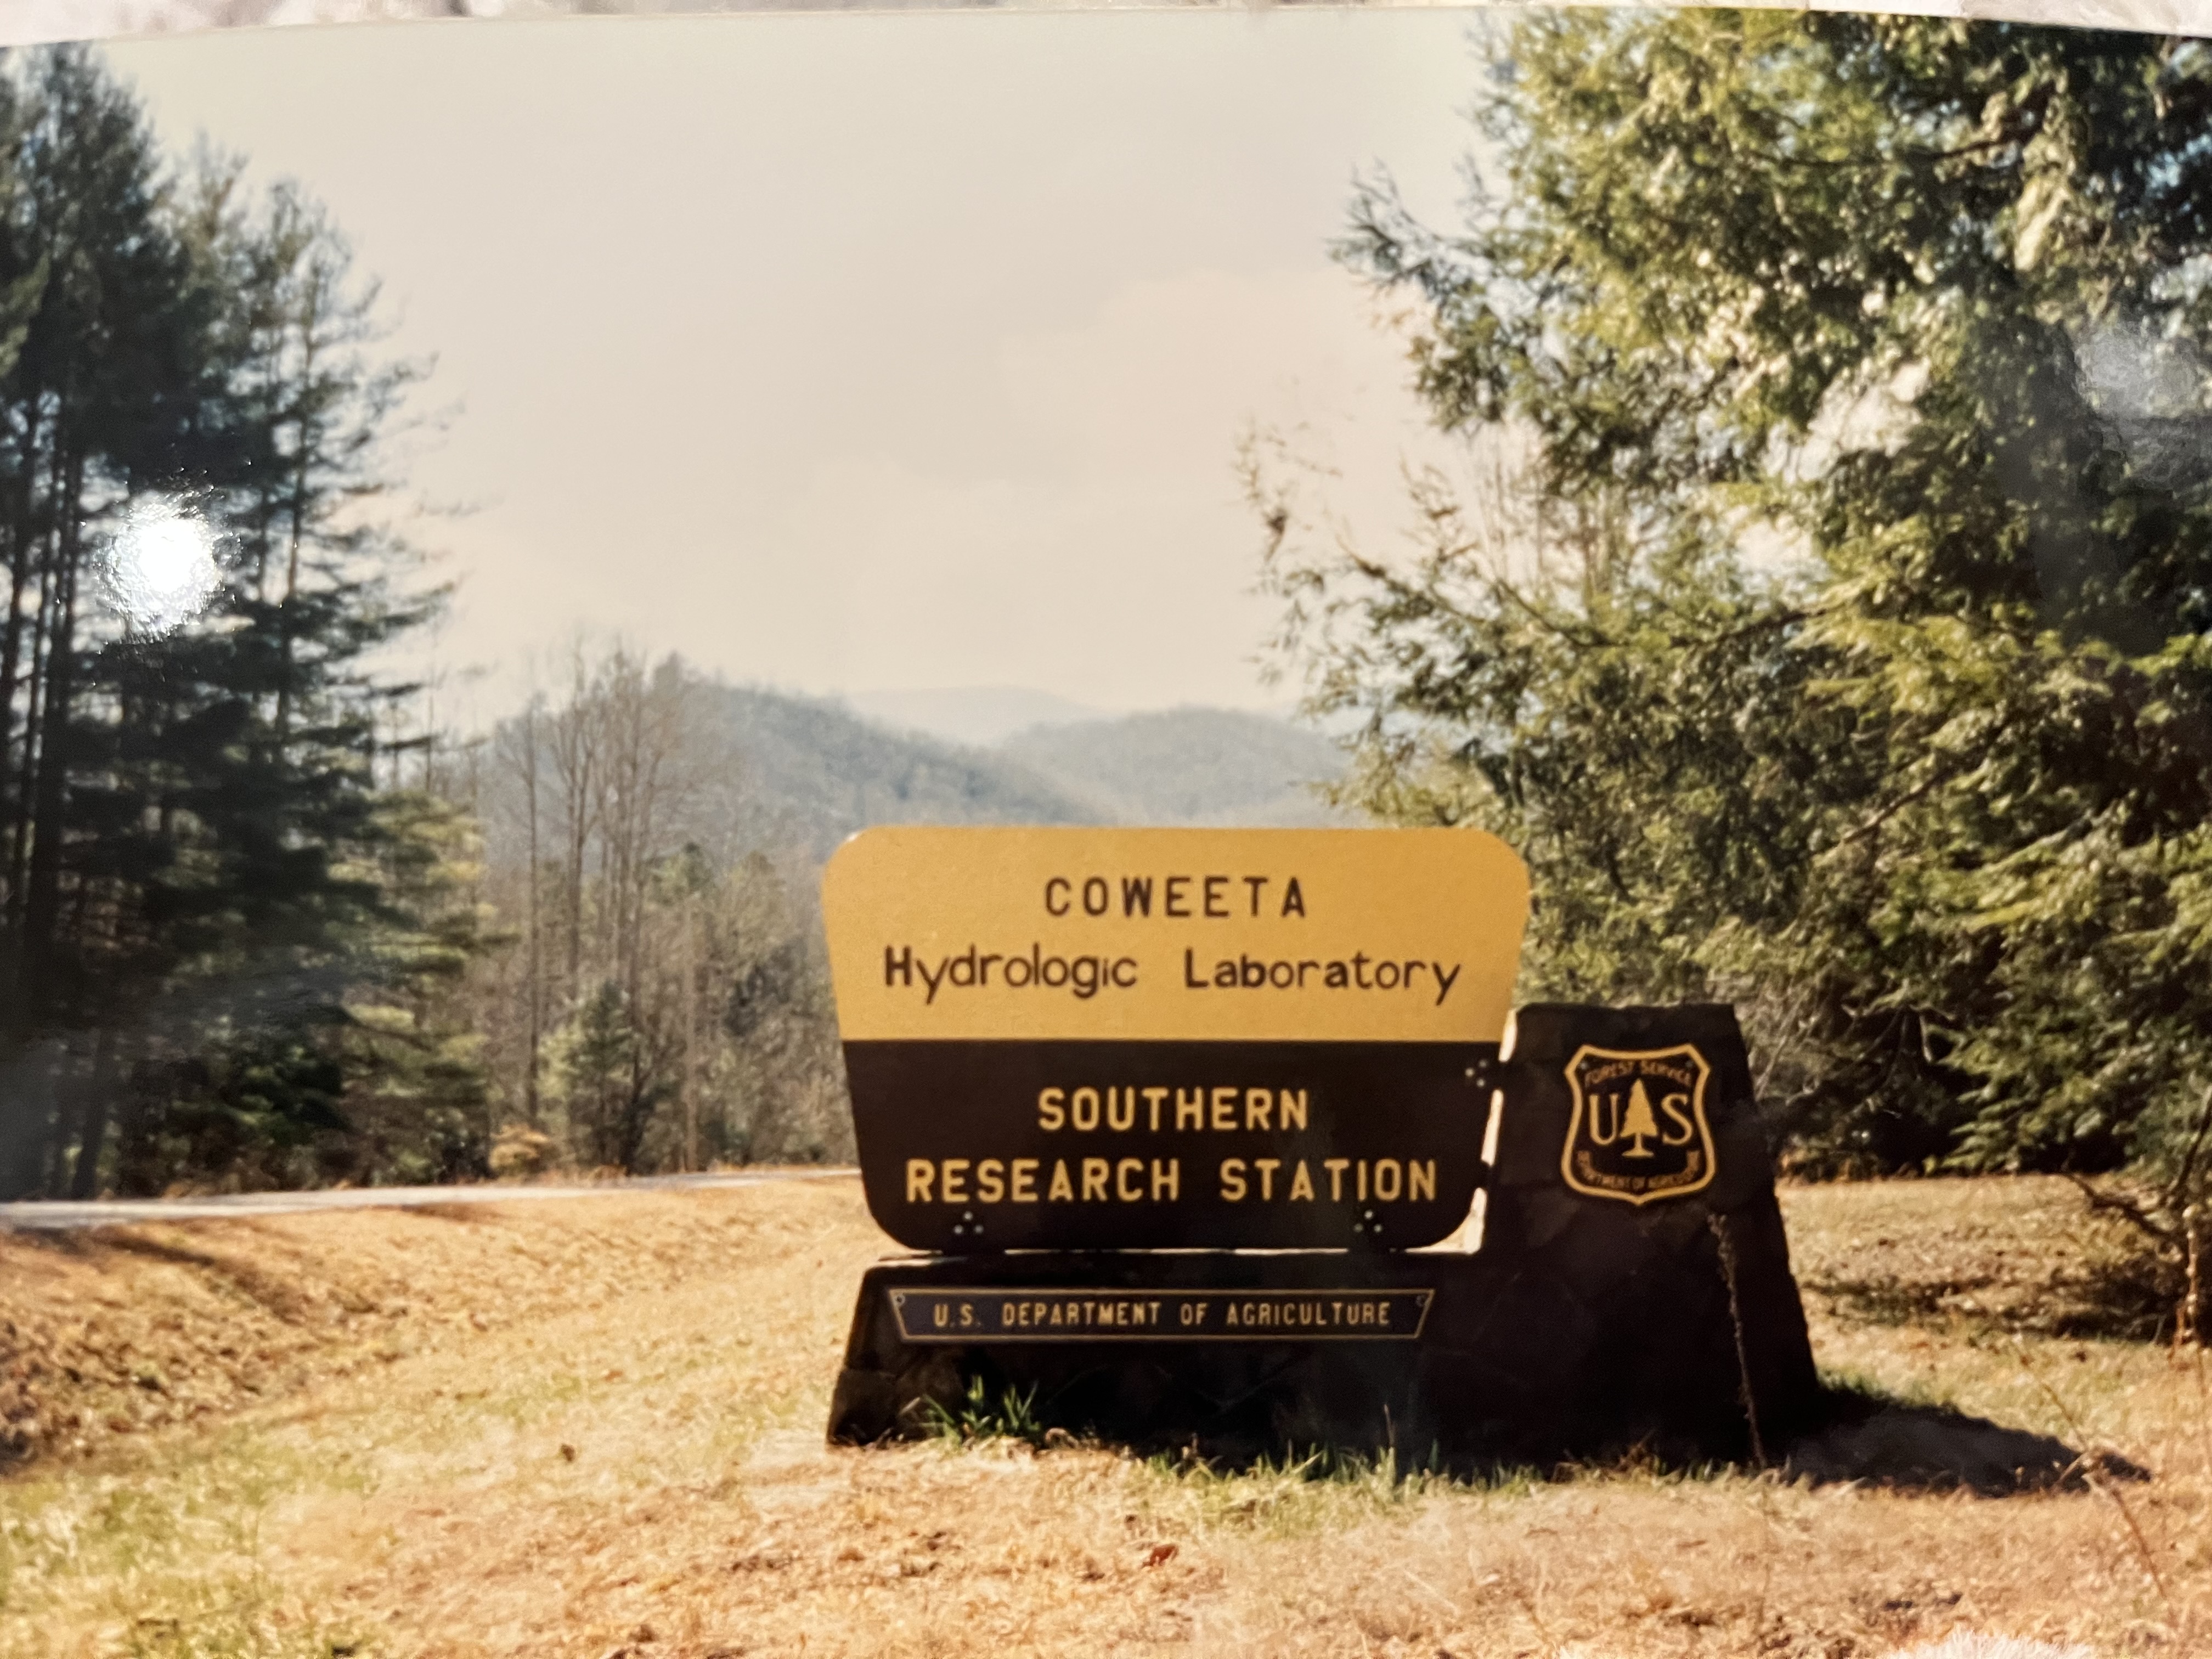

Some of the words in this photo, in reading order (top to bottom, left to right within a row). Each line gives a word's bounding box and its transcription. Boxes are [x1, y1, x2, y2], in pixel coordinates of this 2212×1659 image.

[1045, 876, 1306, 918] COWEETA
[884, 943, 1138, 1005] Hydrologic
[1184, 948, 1461, 1006] Laboratory
[1039, 1086, 1307, 1131] SOUTHERN
[906, 1158, 1179, 1203] RESEARCH
[1220, 1158, 1436, 1202] STATION
[934, 1303, 982, 1328] U.S.
[1002, 1302, 1161, 1327] DEPARTMENT
[1180, 1302, 1207, 1325] OF
[1227, 1302, 1391, 1325] AGRICULTURE
